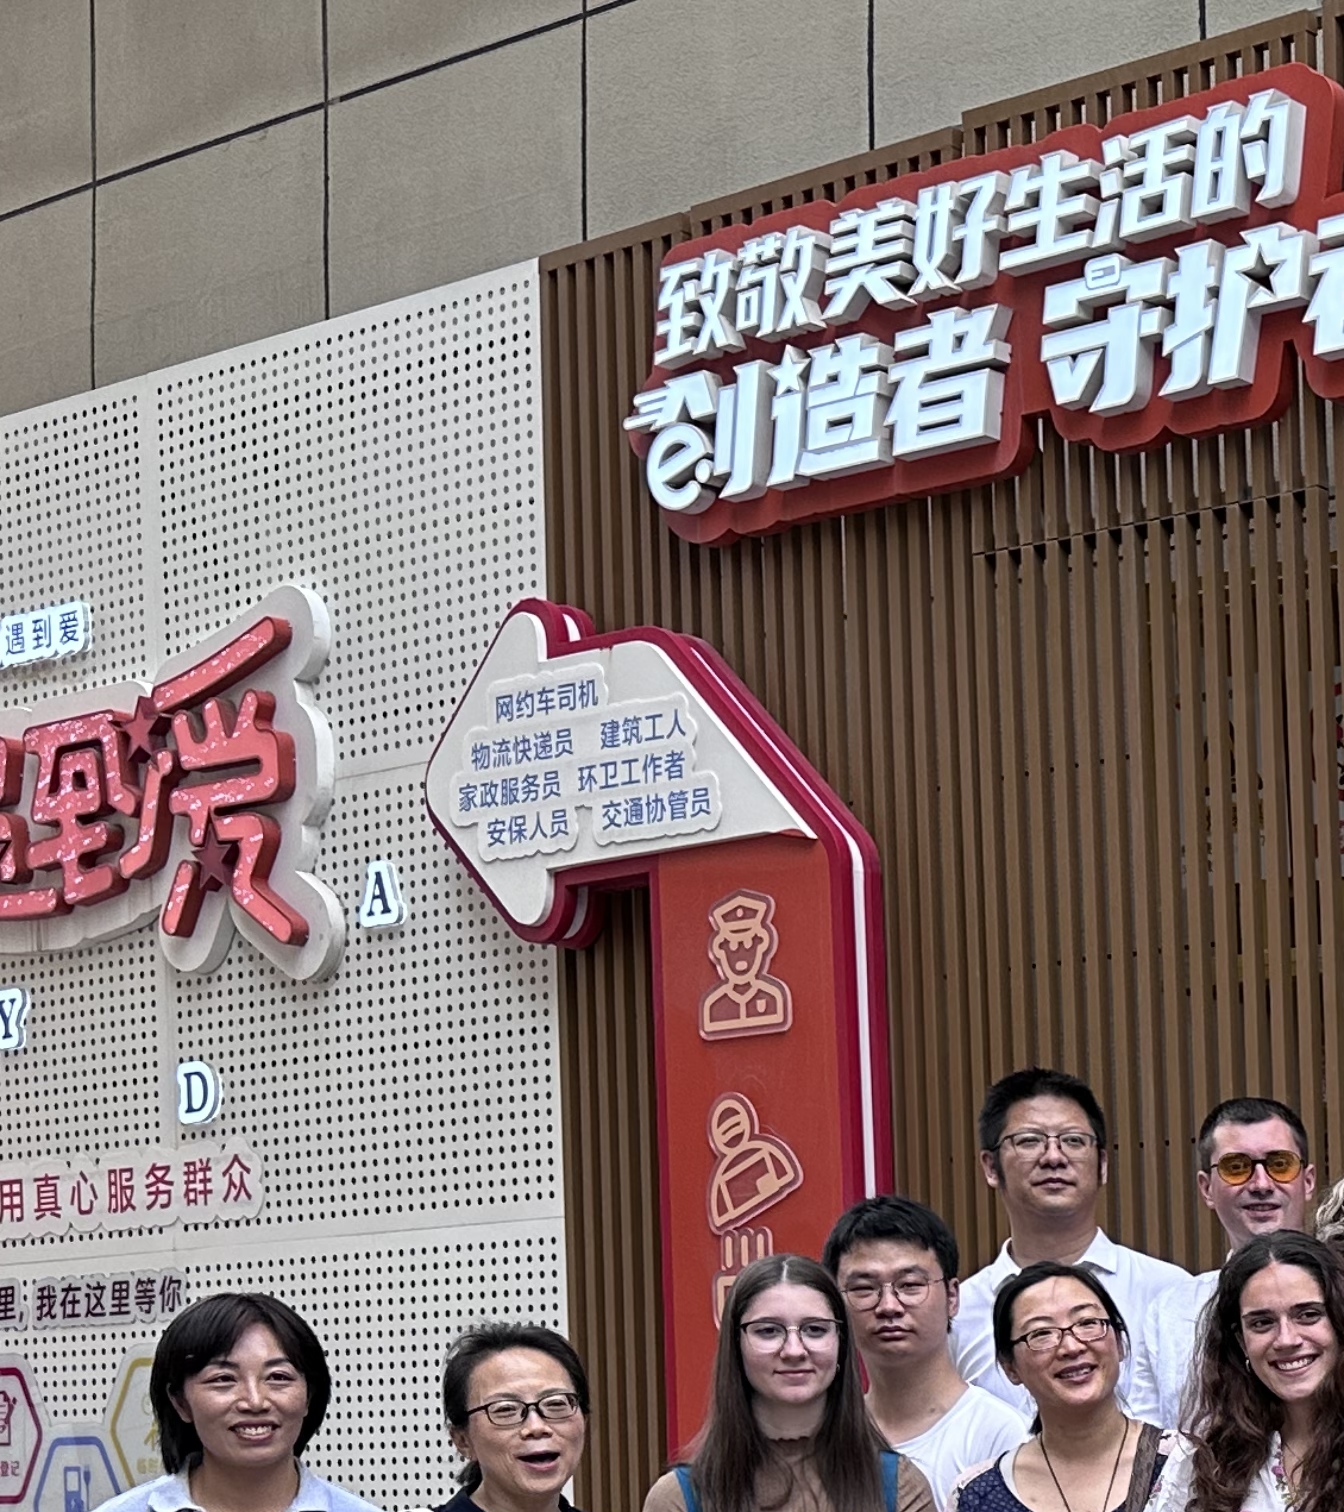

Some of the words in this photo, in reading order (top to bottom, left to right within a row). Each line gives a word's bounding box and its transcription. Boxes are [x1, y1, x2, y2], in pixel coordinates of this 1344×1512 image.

[655, 88, 1307, 371] 致敬美好生活的
[5, 609, 80, 655] 遇到爱
[495, 680, 599, 723] 网约车司机
[471, 728, 574, 772] 物流快递员
[600, 708, 687, 750] 建筑工人
[458, 770, 562, 813] 家政服务员
[577, 750, 686, 793] 环卫工作者
[487, 808, 570, 847] 安保人员
[602, 787, 712, 831] 交通协管员
[367, 874, 393, 919] A
[184, 1071, 210, 1116] D
[0, 1153, 253, 1225] 用真心服务群众
